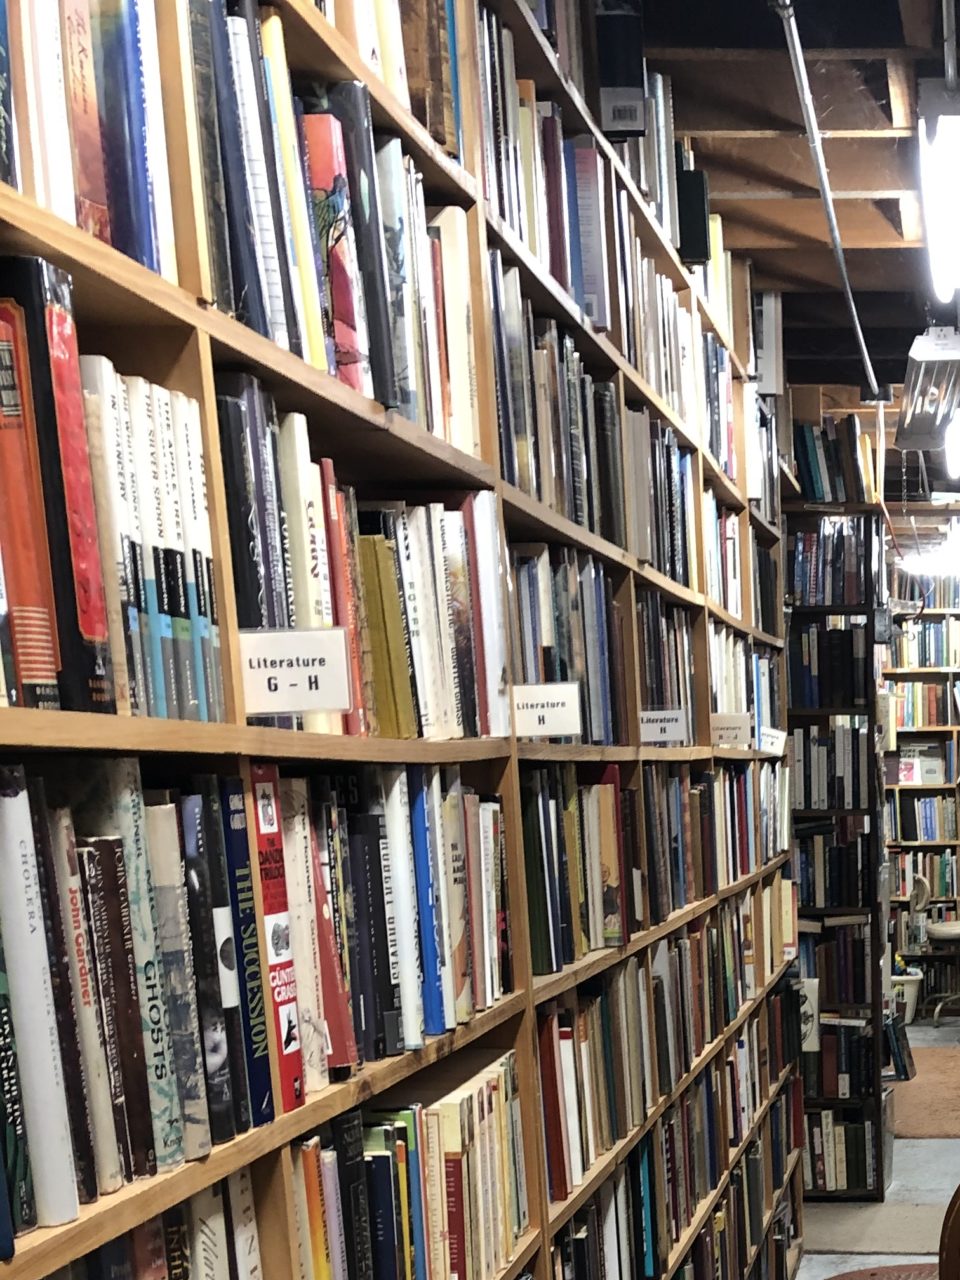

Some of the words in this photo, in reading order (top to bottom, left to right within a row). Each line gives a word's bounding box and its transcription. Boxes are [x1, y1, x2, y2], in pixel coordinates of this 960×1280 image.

[148, 430, 161, 484] SILVER
[164, 402, 172, 431] THE
[173, 500, 182, 541] TREE
[154, 488, 165, 540] SPOON
[279, 511, 296, 628] POWDERKEG
[249, 656, 327, 670] Literature
[267, 676, 279, 693] G
[309, 674, 320, 692] H
[516, 701, 567, 711] Literature
[538, 715, 546, 726] H
[641, 717, 679, 725] Literature
[19, 838, 38, 937] CHOLERA
[113, 846, 129, 886] JOHN
[235, 860, 253, 914] THE
[302, 835, 313, 904] Flounder
[68, 886, 84, 931] John
[117, 888, 134, 950] GARDNER
[73, 933, 96, 1009] Gardner
[126, 953, 141, 1002] Grendel
[239, 922, 269, 1060] SUCCESSION
[144, 961, 170, 1081] GHOSTS
